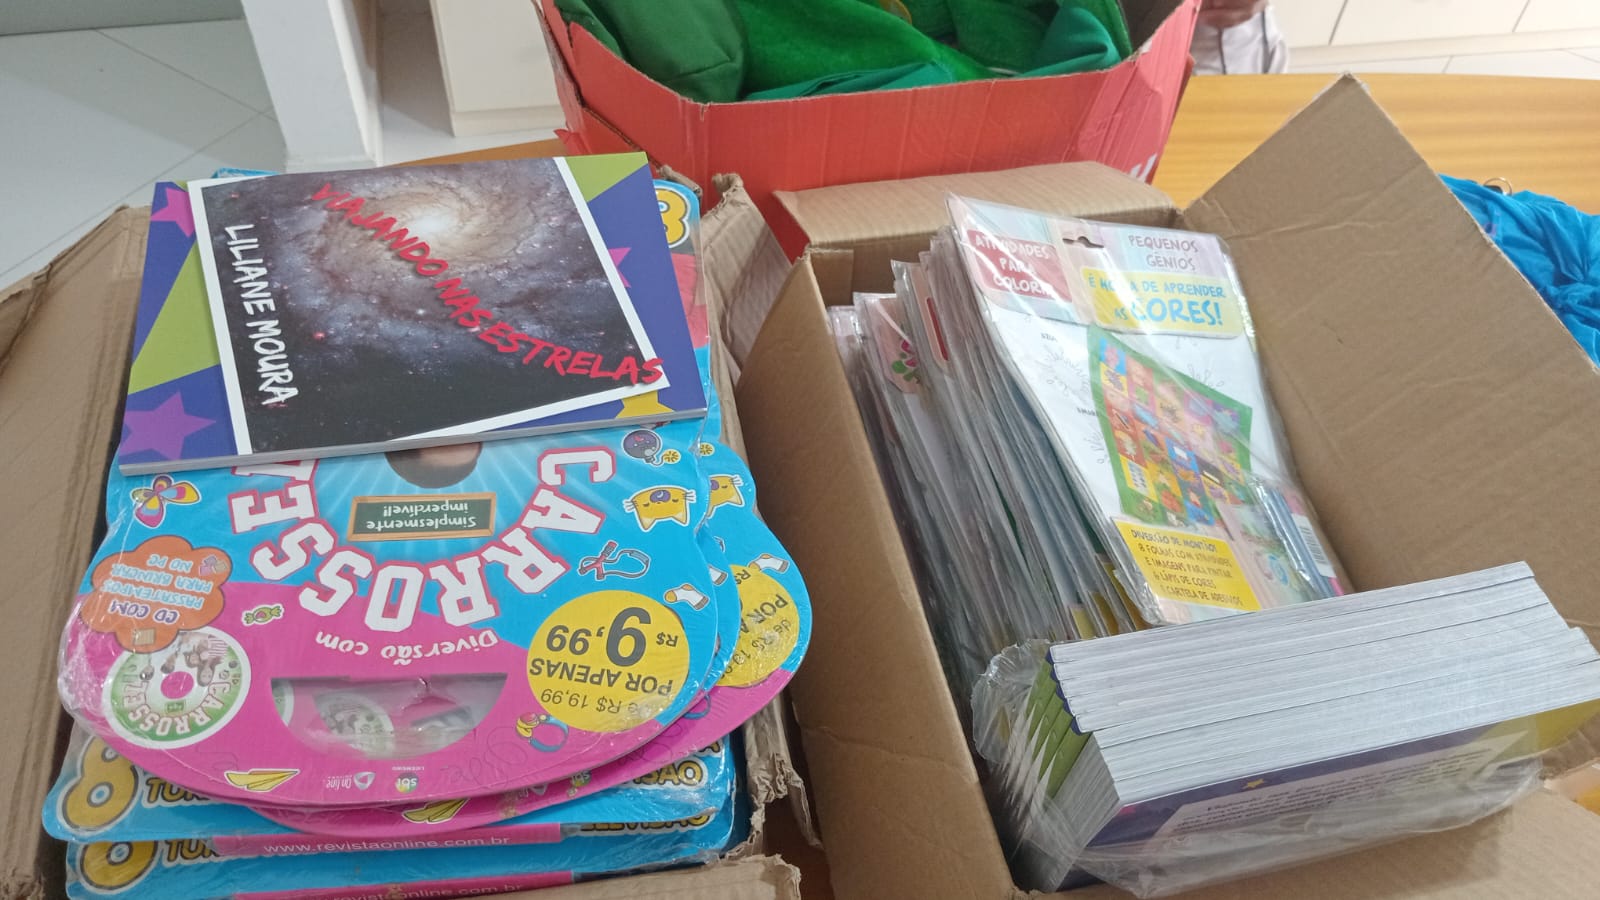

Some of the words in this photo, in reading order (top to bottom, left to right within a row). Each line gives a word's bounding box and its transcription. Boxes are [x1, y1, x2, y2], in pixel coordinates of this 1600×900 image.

[1128, 234, 1198, 253] PEQUENOS
[225, 224, 276, 315] LILIANE
[311, 182, 449, 276] VIAJANDO
[434, 278, 493, 328] NAS
[478, 321, 664, 385] ESTRELAS
[1141, 280, 1159, 293] DE
[1164, 281, 1226, 299] APRENDER
[245, 319, 299, 405] MOURA
[382, 499, 469, 518] imperdível!
[366, 513, 477, 532] Simplesmente
[146, 553, 167, 568] PC
[169, 558, 194, 573] NO
[111, 563, 174, 587] BRINCAR
[174, 575, 214, 595] PARA
[102, 580, 206, 610] PASSATEMPOS
[108, 600, 150, 619] COM
[153, 607, 180, 624] CD
[315, 630, 369, 656] com
[545, 606, 652, 667] 9,99
[655, 632, 679, 648] R$
[380, 629, 499, 666] Diversão
[528, 657, 623, 688] APENAS
[624, 671, 674, 697] POR
[540, 688, 589, 710] 19,99
[595, 696, 623, 715] R$
[263, 836, 511, 854] www.revistaonline.com.br
